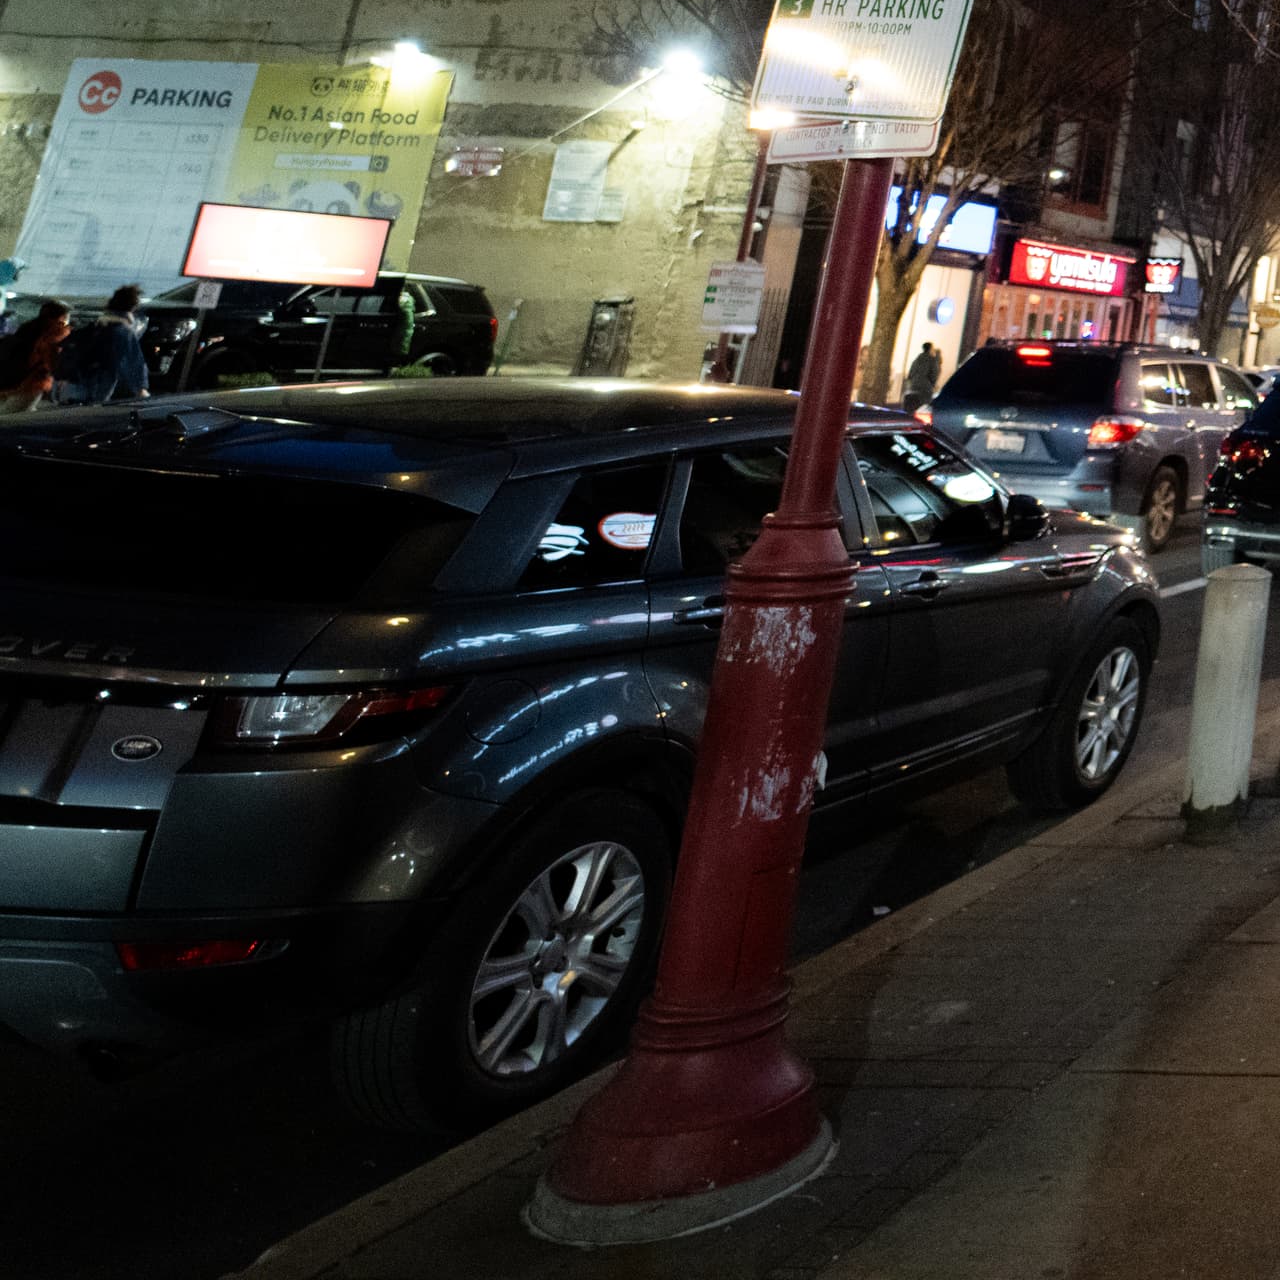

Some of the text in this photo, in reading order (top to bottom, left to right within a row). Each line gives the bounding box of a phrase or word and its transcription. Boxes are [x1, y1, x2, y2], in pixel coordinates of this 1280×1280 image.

[131, 88, 233, 109] PARKING
[268, 105, 419, 126] No.1 Asian Food
[254, 126, 421, 148] Delivery Platform
[872, 122, 889, 134] NOT
